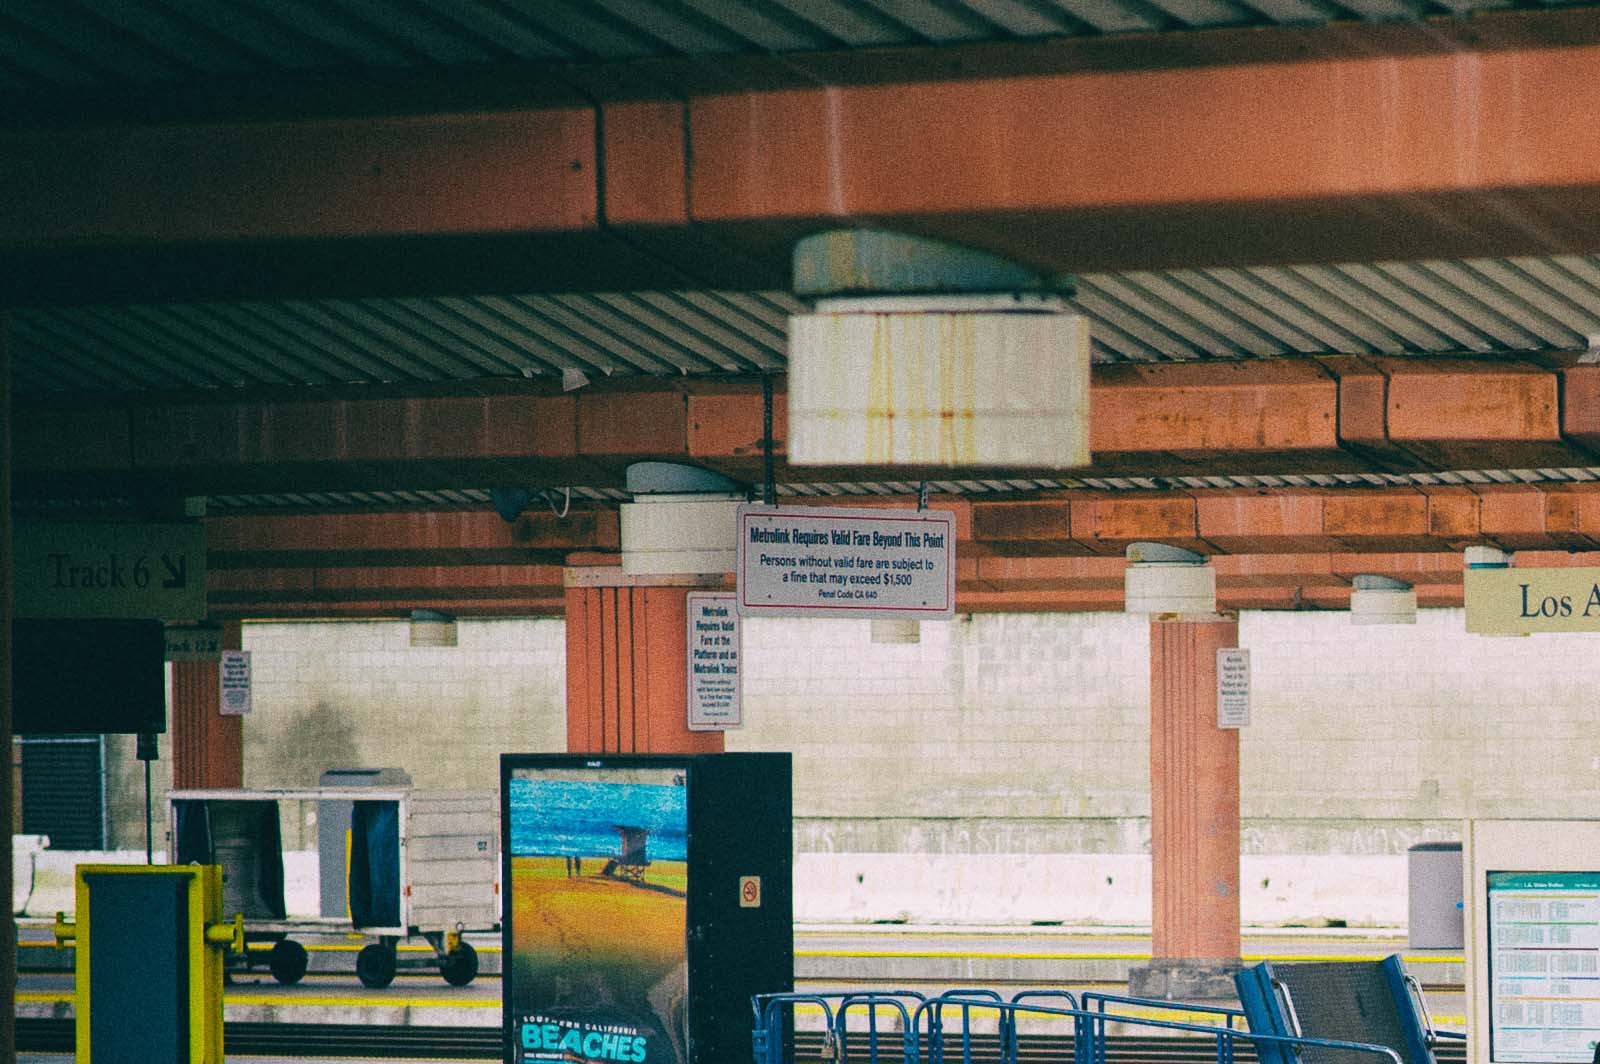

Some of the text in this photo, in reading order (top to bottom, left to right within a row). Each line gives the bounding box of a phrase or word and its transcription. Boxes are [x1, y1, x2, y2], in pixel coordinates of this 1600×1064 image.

[751, 527, 944, 549] Metrolink Requires Valid Fare Beyond This Point
[48, 552, 150, 589] Track 6
[760, 553, 934, 571] Persons without valid fare are subject to
[782, 570, 912, 587] a fine that may exceed $1,500
[1518, 583, 1572, 618] Los
[585, 1023, 638, 1035] CALIFORNIA
[521, 1023, 647, 1063] BEACHES
